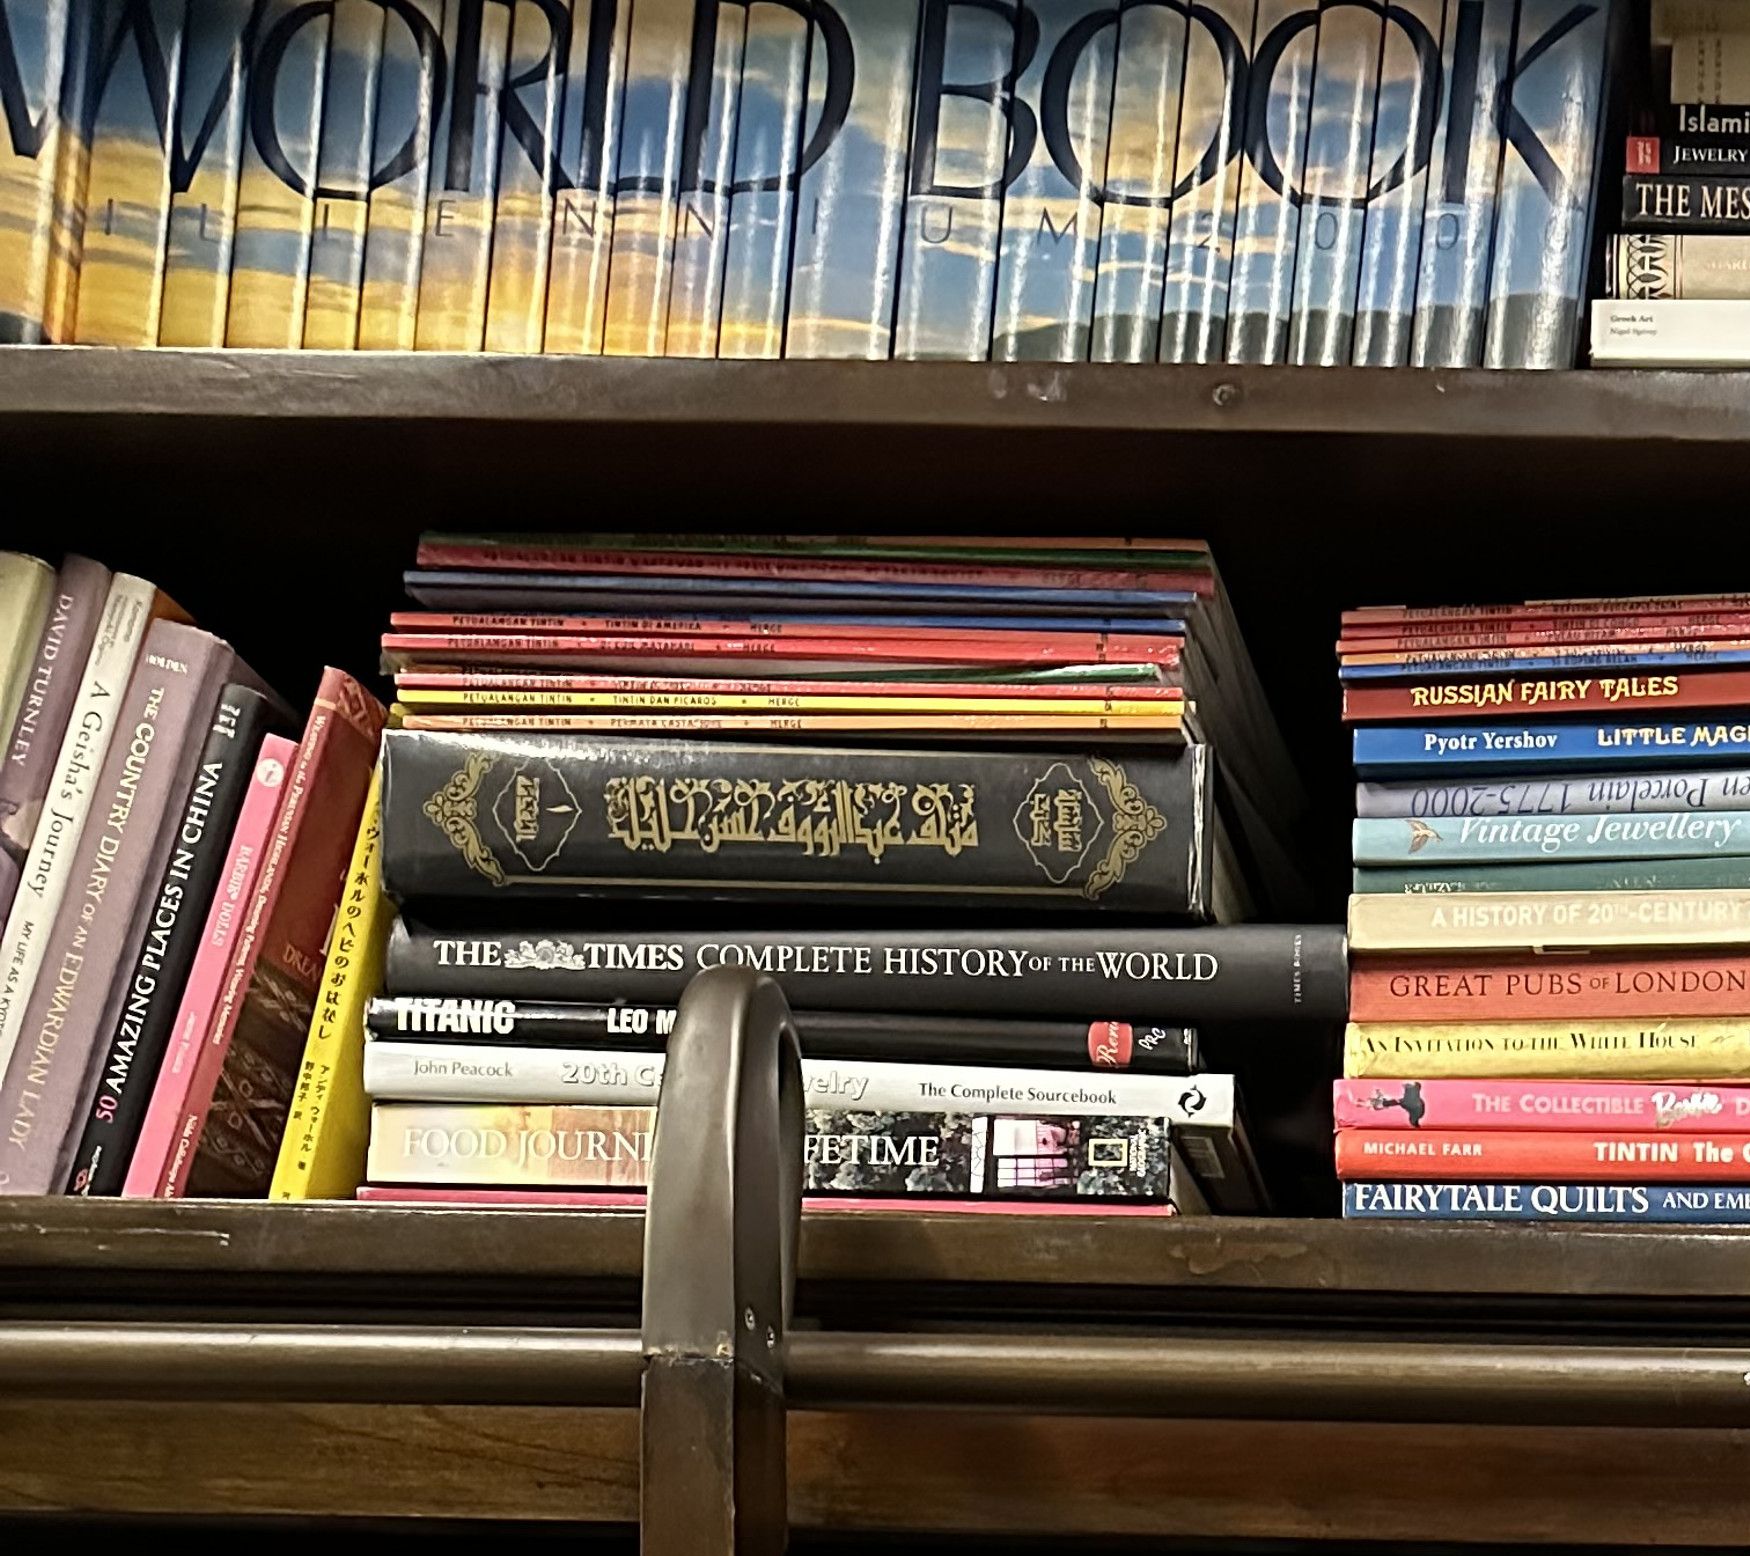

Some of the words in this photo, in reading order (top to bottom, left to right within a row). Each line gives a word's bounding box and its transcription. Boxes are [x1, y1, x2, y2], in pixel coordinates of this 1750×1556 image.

[909, 0, 1598, 207] BOOK
[1673, 146, 1748, 163] JEWELRY
[1636, 184, 1690, 216] THE
[92, 681, 110, 698] A
[1411, 679, 1514, 707] RUSSIAN
[1521, 677, 1590, 704] FAIRY
[1600, 675, 1679, 700] TALES
[1424, 732, 1476, 754] Pyotr
[1481, 730, 1558, 750] Yershov
[1597, 723, 1686, 746] LITTLE
[59, 710, 104, 802] Geisha's
[1411, 781, 1571, 816] 1775-2000
[1589, 772, 1707, 809] Porcelain
[1459, 816, 1580, 852] Vintage
[1588, 814, 1740, 848] Jewellery
[28, 807, 74, 897] Journey
[96, 1094, 119, 1123] 50
[109, 974, 157, 1093] AMAZING
[142, 879, 183, 971] PLACES
[171, 850, 192, 881] IN
[183, 762, 223, 845] CHINA
[434, 941, 501, 967] THE
[583, 943, 683, 971] TIMES
[697, 943, 870, 976] COMPLETE
[884, 949, 1027, 976] HISTORY
[1029, 957, 1051, 971] OF
[1059, 957, 1095, 971] THE
[1096, 951, 1217, 980] WORLD
[1390, 974, 1493, 998] GREAT
[1504, 972, 1583, 996] PUBS
[1590, 977, 1609, 990] OF
[1615, 969, 1747, 994] LONDON
[413, 1060, 450, 1078] John
[453, 1060, 514, 1079] Peacock
[919, 1082, 946, 1100] The
[950, 1084, 1026, 1104] Complete
[1027, 1087, 1117, 1106] Sourcebook
[1364, 1143, 1437, 1156] MICHAEL
[1442, 1144, 1482, 1156] FARR
[1594, 1142, 1679, 1164] TINTIN
[1694, 1142, 1734, 1164] The
[1355, 1183, 1524, 1213] FAIRYTALE
[1531, 1183, 1649, 1215] QUILTS
[1663, 1193, 1707, 1209] AND
